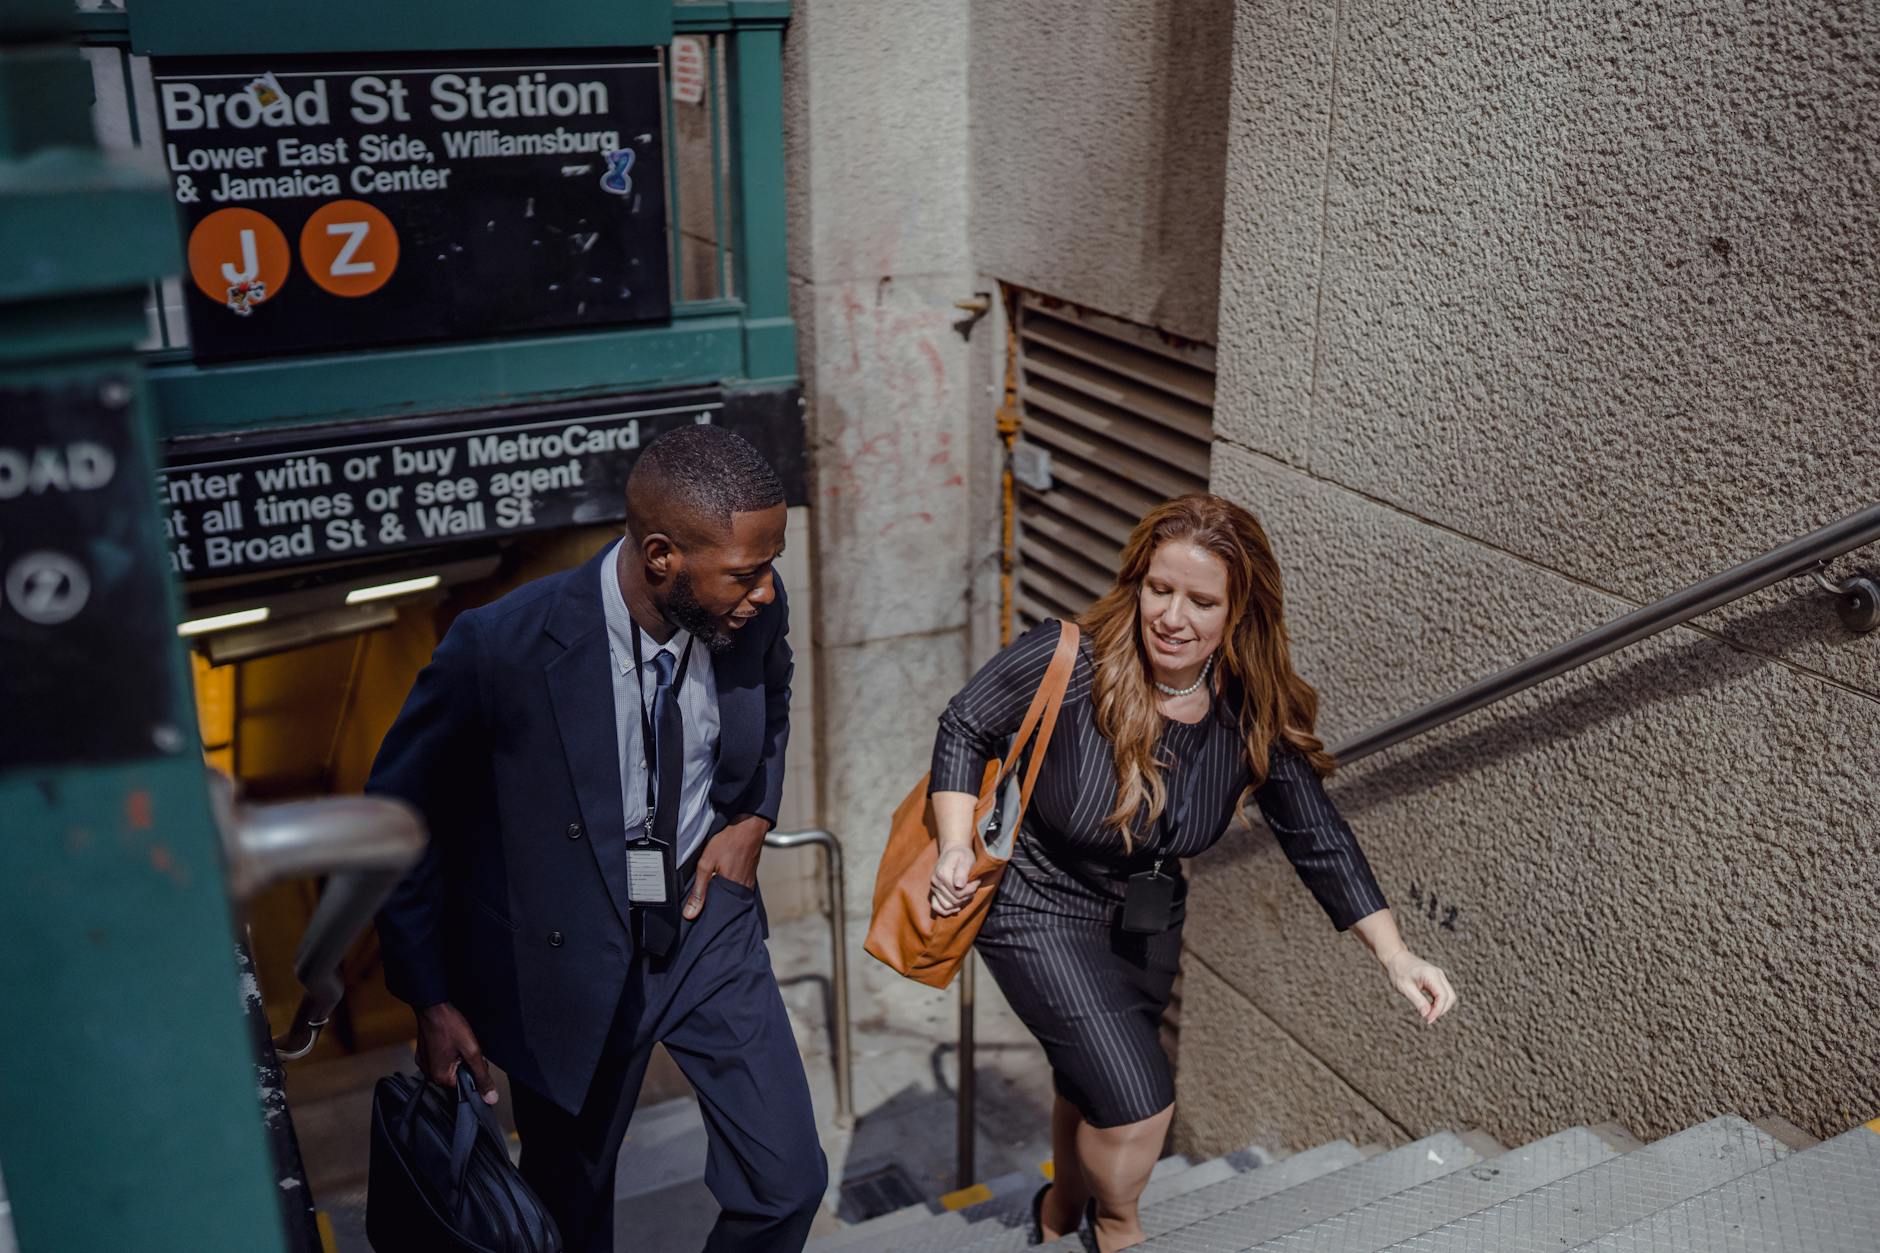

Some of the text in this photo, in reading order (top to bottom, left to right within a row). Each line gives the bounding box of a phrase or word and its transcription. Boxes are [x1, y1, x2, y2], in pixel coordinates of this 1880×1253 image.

[161, 72, 609, 131] Broad St Station
[167, 127, 620, 171] Lower East Side, Williamsburg
[176, 164, 451, 203] & Jamaica Center
[221, 222, 376, 284] J Z
[255, 456, 332, 492] with
[343, 455, 382, 482] or
[392, 446, 457, 477] buy
[467, 419, 640, 467] MetroCard
[202, 500, 243, 534] all
[254, 493, 354, 526] times
[366, 485, 403, 512] or
[415, 477, 479, 506] see
[489, 458, 584, 498] agent
[205, 524, 315, 568] Broad
[325, 518, 368, 551] St
[378, 512, 407, 544] &
[416, 501, 486, 538] Wall
[495, 496, 536, 528] St
